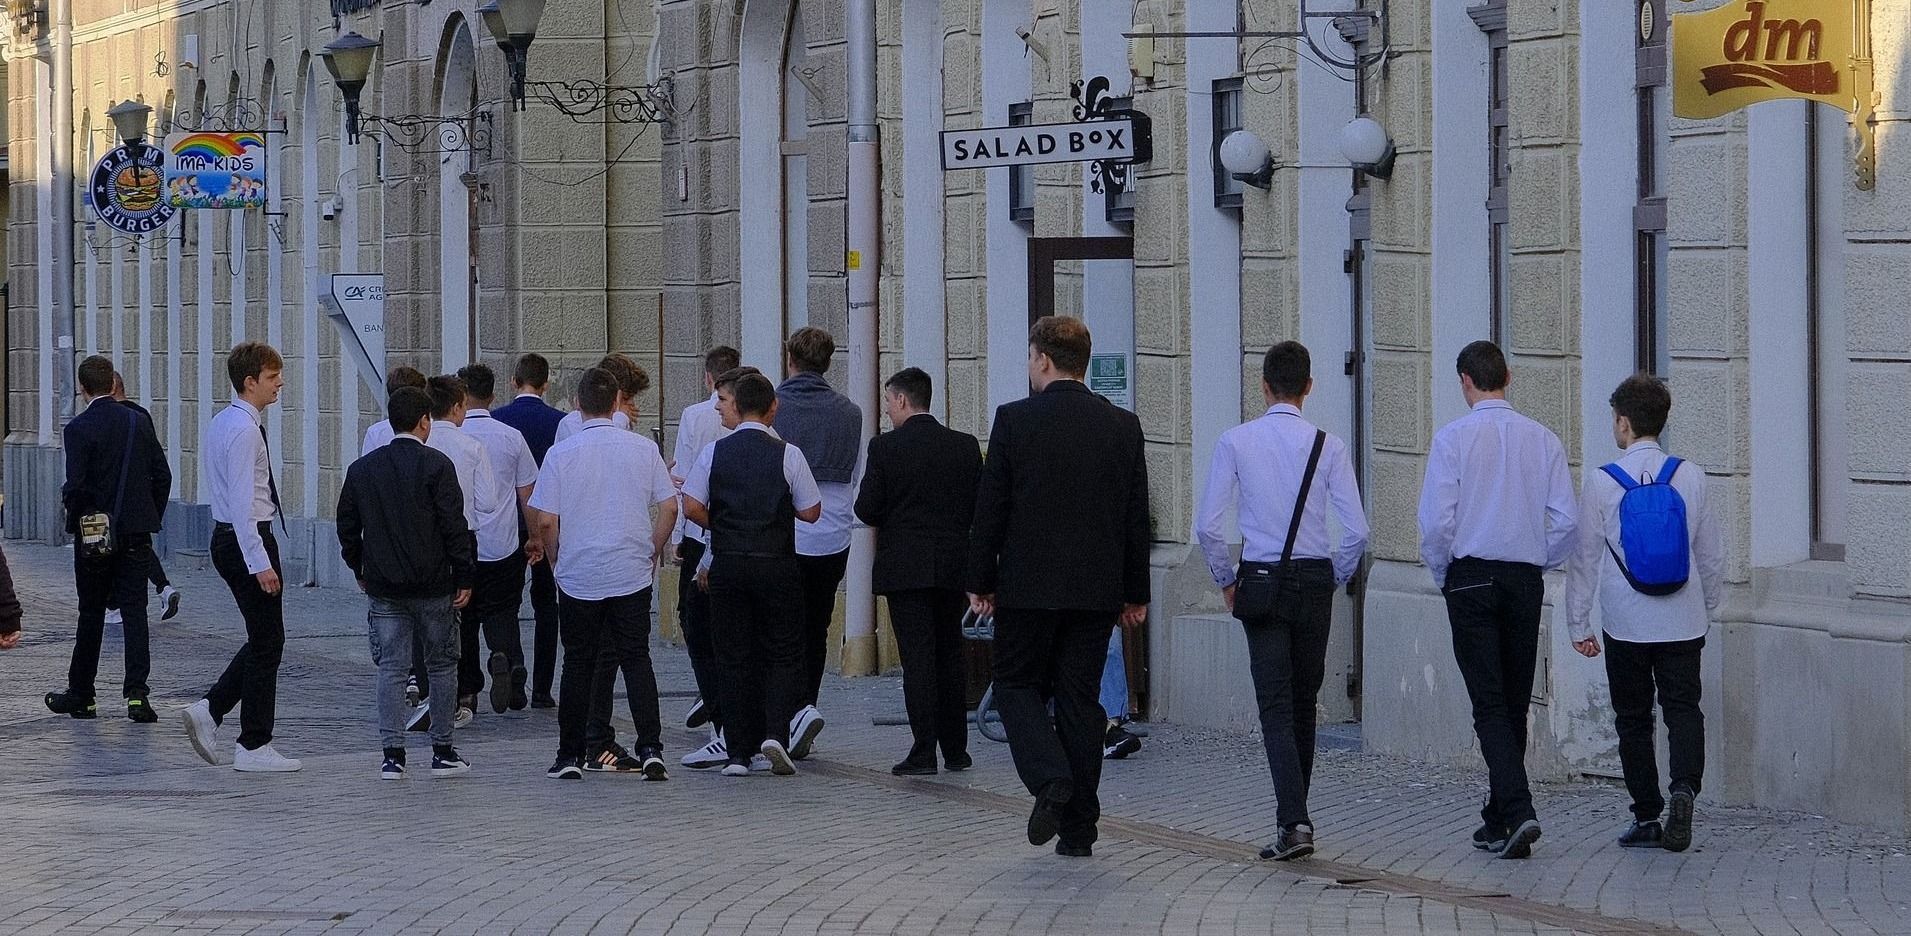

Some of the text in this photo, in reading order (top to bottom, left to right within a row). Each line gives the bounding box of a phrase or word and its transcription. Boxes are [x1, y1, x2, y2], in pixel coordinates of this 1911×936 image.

[1723, 2, 1822, 61] dm
[102, 147, 159, 172] PRM
[954, 134, 1056, 161] SALAD
[176, 155, 254, 172] IMA KIDS
[102, 205, 174, 231] BURGER
[364, 324, 384, 333] BAN
